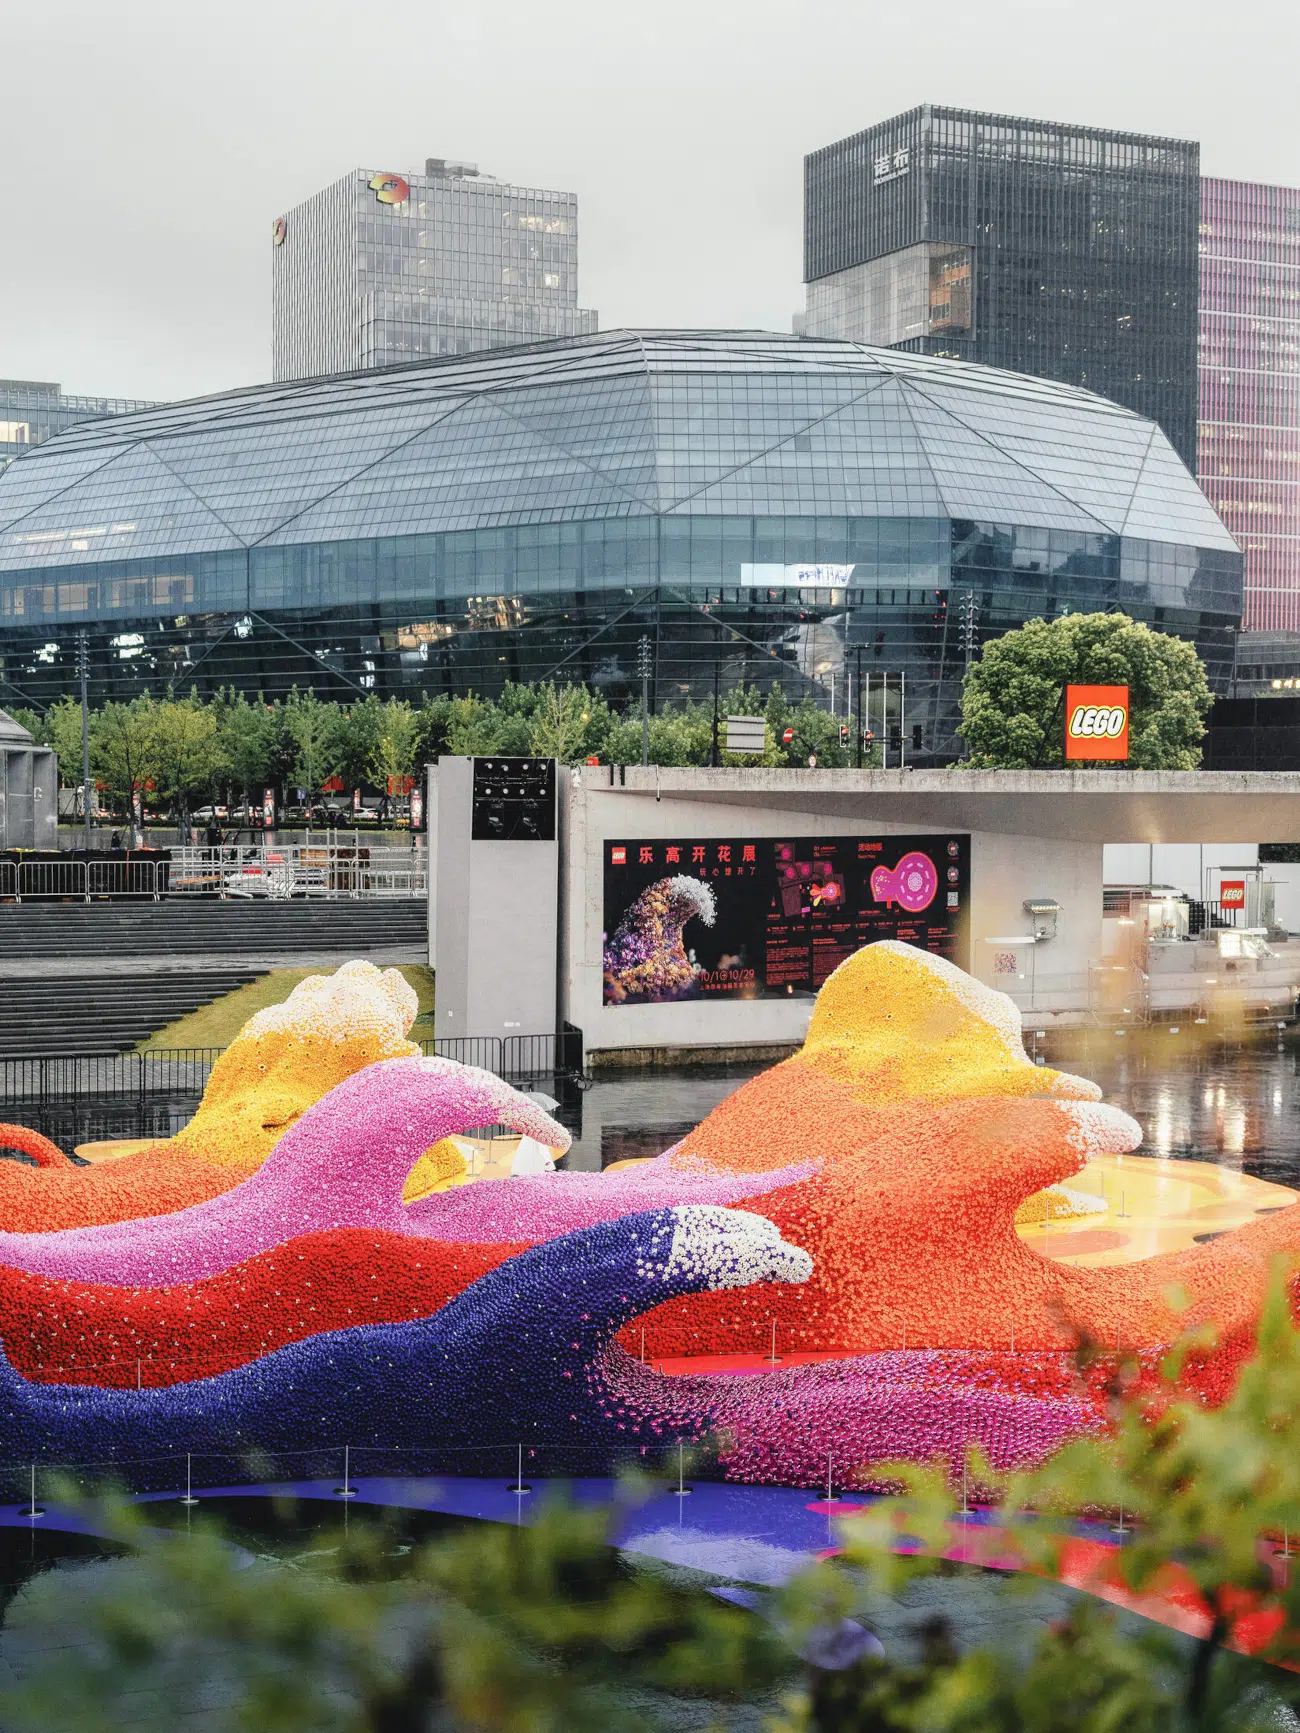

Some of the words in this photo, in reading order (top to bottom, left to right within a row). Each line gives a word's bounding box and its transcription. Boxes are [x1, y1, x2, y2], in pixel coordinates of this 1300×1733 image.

[874, 148, 909, 177] 诺布
[1070, 706, 1126, 738] LEGO
[1223, 888, 1243, 901] LEGO
